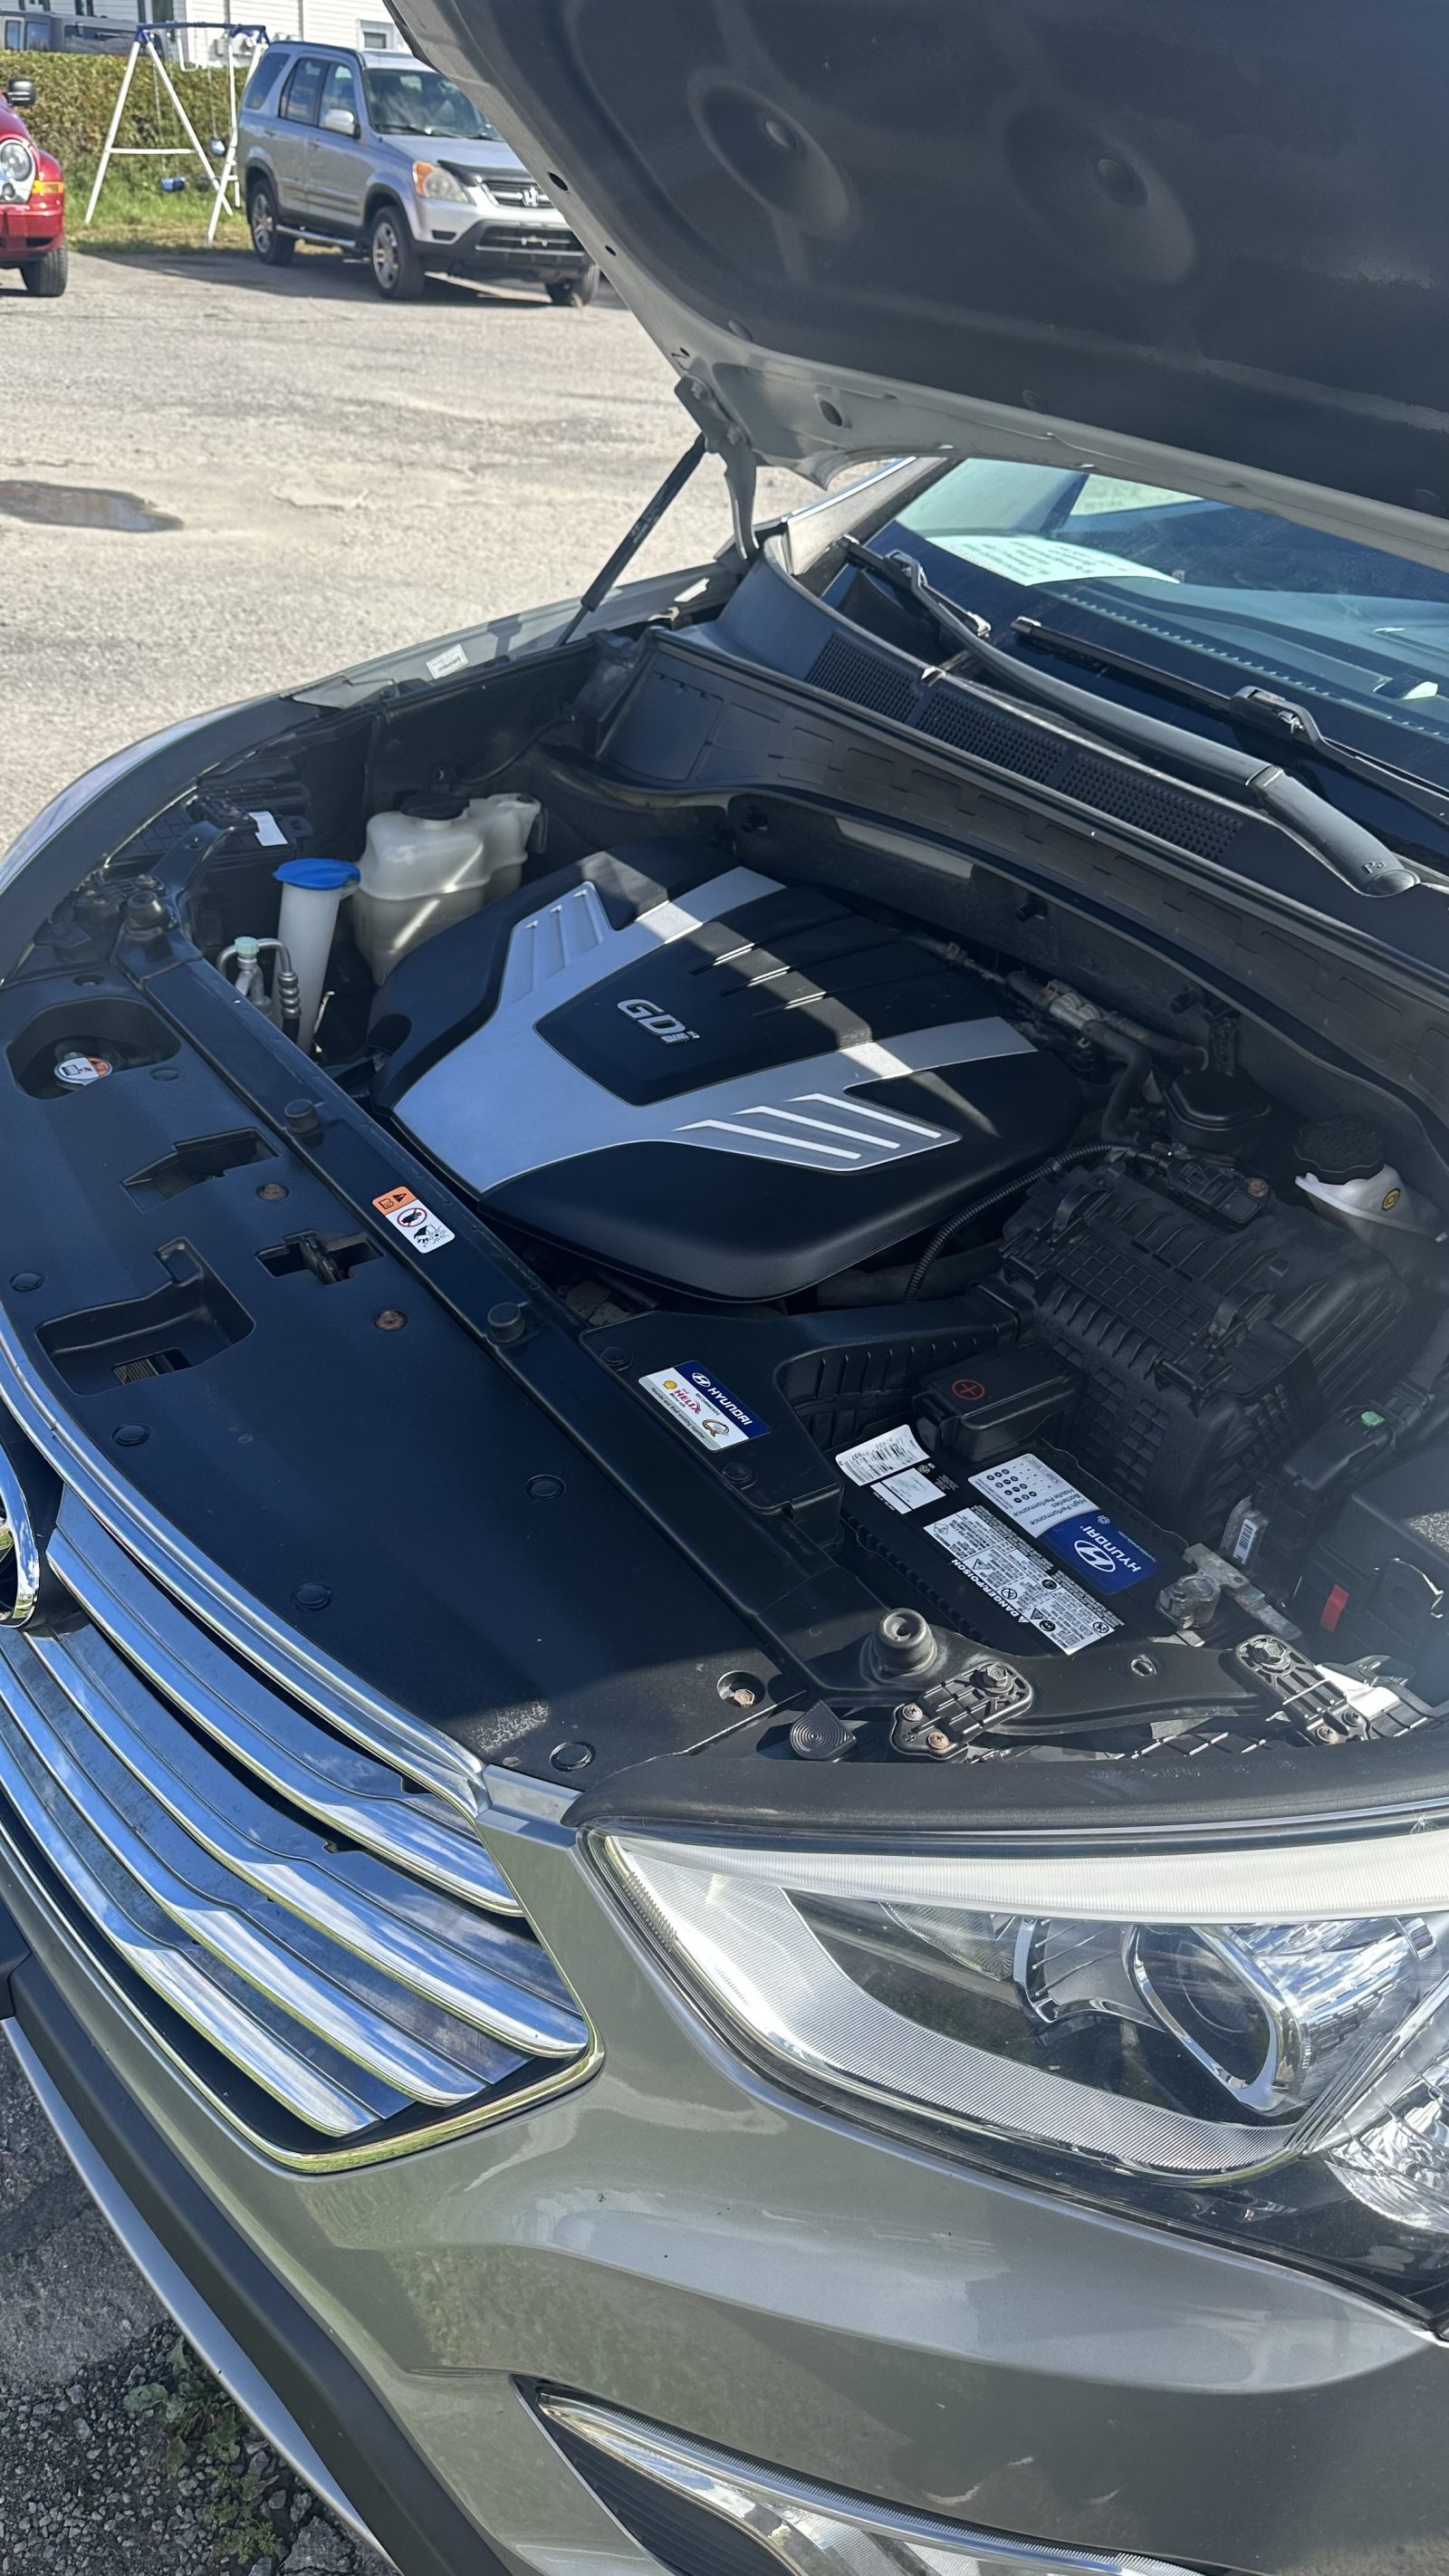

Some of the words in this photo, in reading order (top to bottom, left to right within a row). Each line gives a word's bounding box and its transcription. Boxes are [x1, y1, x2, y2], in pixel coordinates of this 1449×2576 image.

[617, 998, 700, 1044] GDi
[674, 1389, 702, 1415] HELIX
[705, 1387, 753, 1425] HYUNDAI
[1050, 1493, 1080, 1508] Batteries
[1053, 1487, 1075, 1499] Haute
[1070, 1497, 1087, 1507] High
[1011, 1495, 1056, 1517] Performance
[1028, 1504, 1072, 1525] Performance
[1081, 1523, 1142, 1573] HYUNDAI
[952, 1559, 1021, 1618] DANGER/POISON
